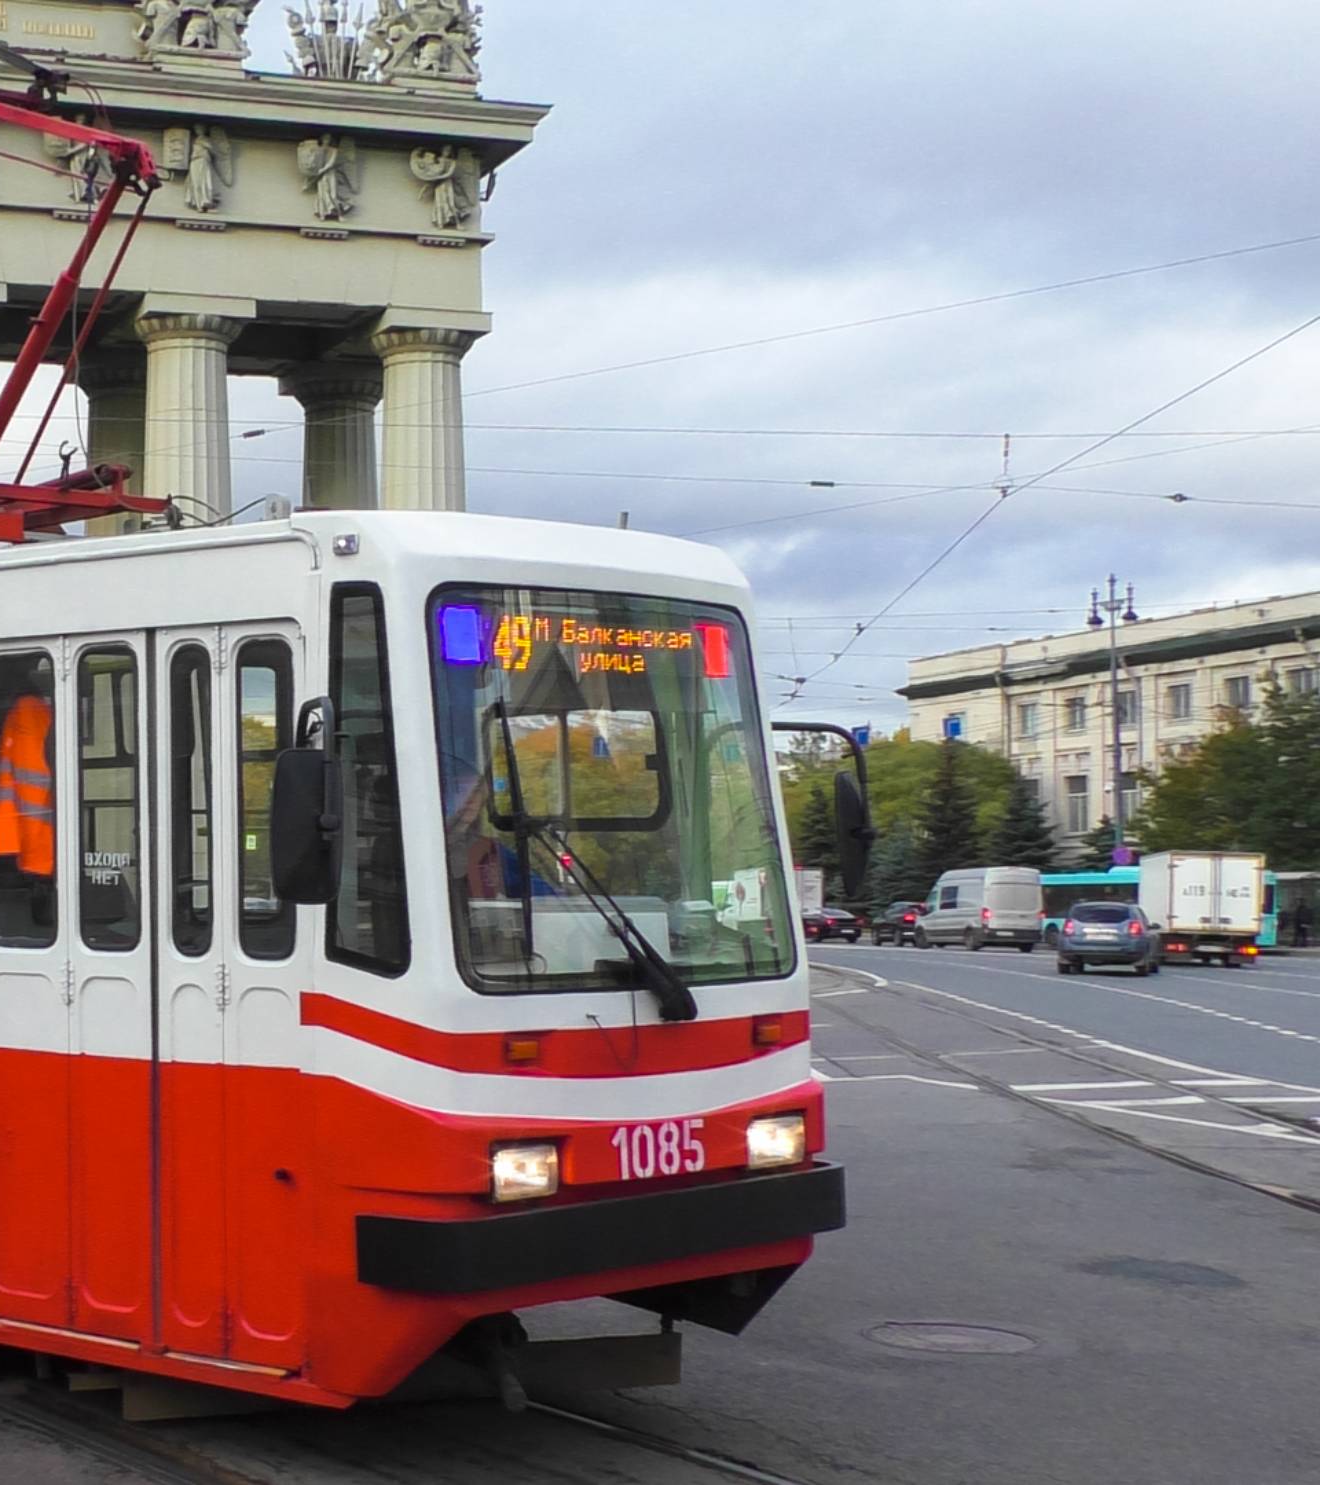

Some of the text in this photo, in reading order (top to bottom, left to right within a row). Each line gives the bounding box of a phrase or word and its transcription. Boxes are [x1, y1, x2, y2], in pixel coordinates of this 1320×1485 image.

[493, 615, 532, 670] 49
[561, 618, 693, 650] Балканская
[580, 652, 646, 674] улица
[91, 870, 122, 886] НЕТ
[611, 1118, 705, 1180] 1085
